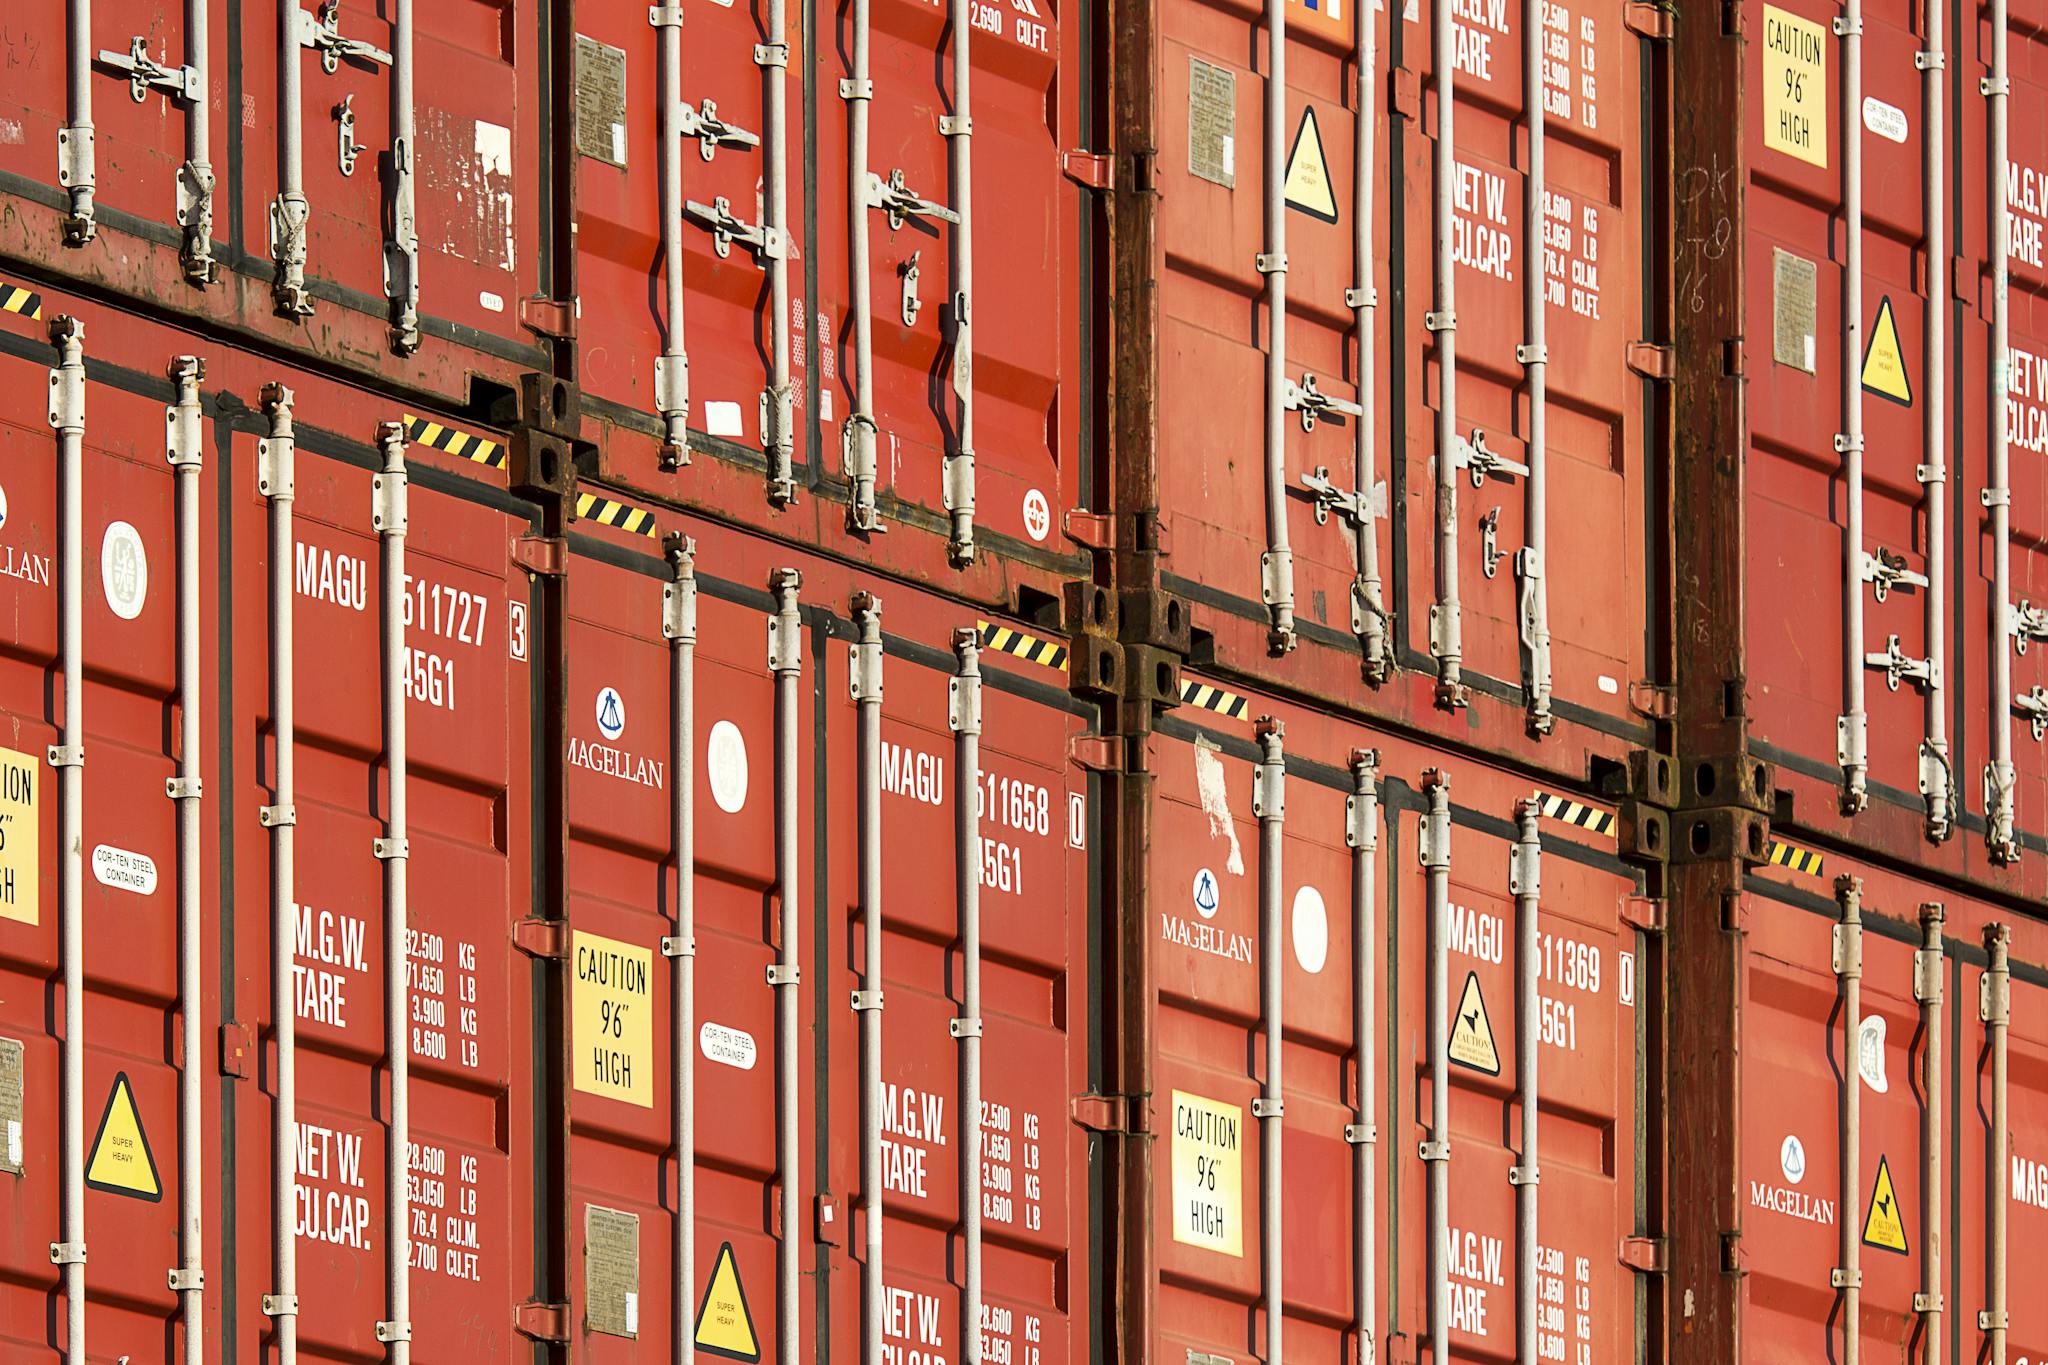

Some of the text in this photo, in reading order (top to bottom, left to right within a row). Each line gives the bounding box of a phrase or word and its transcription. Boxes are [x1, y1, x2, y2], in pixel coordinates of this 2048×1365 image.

[970, 1, 1001, 35] 2.690
[1016, 18, 1048, 52] CU.FT.
[1543, 1, 1595, 43] 2.500 KG
[1768, 18, 1820, 67] CAUTION
[1452, 22, 1491, 81] TARE
[1543, 30, 1595, 72] 1.650 LB
[1543, 58, 1596, 100] 3.900 KG
[1543, 87, 1596, 129] 8.600 LB
[1780, 109, 1809, 148] HIGH
[1452, 160, 1507, 225] NET W.
[1544, 191, 1597, 233] 8.600 KG
[1452, 214, 1512, 281] CU.CAP.
[1544, 220, 1597, 261] 3.050 LB
[2006, 211, 2043, 269] TARE
[1544, 248, 1600, 291] 76.4 CU.M.
[1544, 278, 1600, 321] .700 CU.FT.
[2007, 347, 2033, 398] NET
[296, 541, 526, 658] MAGU 511727 3
[404, 647, 454, 711] 45G1
[881, 741, 943, 806] MAGU
[97, 849, 153, 875] COR-TEN STEEL
[106, 867, 146, 888] CONTAINER
[293, 903, 368, 973] M.G.W.
[406, 928, 475, 971] 32.500 KG
[1161, 913, 1252, 964] MAGELLAN
[1447, 903, 1503, 964] MAGU
[406, 961, 476, 1003] 71.650 LB
[578, 946, 646, 995] CAUTION
[293, 963, 346, 1028] TARE
[412, 995, 477, 1036] 3.900 KG
[413, 1027, 478, 1068] 8.600 LB
[705, 1026, 752, 1050] COR-TEN STEEL
[712, 1044, 745, 1062] CONTAINER
[594, 1047, 631, 1088] HIGH
[880, 1081, 946, 1146] M.G.W.
[1024, 1112, 1039, 1140] KG
[1178, 1105, 1236, 1150] CAUTION
[112, 1136, 133, 1149] SUPER
[112, 1151, 133, 1164] HEAVY
[294, 1122, 364, 1188] NET W.
[407, 1141, 477, 1184] 28.600 KG
[1024, 1143, 1039, 1170] LB
[881, 1140, 927, 1198] TARE
[983, 1162, 1040, 1201] 3.900 KG
[2012, 1155, 2048, 1210] MAG
[293, 1184, 371, 1250] CU.CAP.
[460, 1187, 476, 1216] LB
[983, 1193, 1041, 1231] 8.600 LB
[1191, 1200, 1224, 1238] HIGH
[1751, 1181, 1834, 1225] MAGELLAN
[412, 1208, 480, 1250] 76.4 CU.M.
[446, 1248, 480, 1282] CU.FT.
[1447, 1227, 1504, 1286] M.G.W.
[1536, 1246, 1590, 1283] 2.500 KG
[717, 1301, 735, 1312] SUPER
[1447, 1281, 1487, 1336] TARE
[1536, 1275, 1590, 1311] 1.650 LB
[717, 1315, 735, 1327] HEAVY
[882, 1285, 942, 1347] NET W.
[1026, 1315, 1040, 1343] KG
[1538, 1303, 1590, 1340] 3.900 KG
[1538, 1332, 1591, 1365] 8.600 LB
